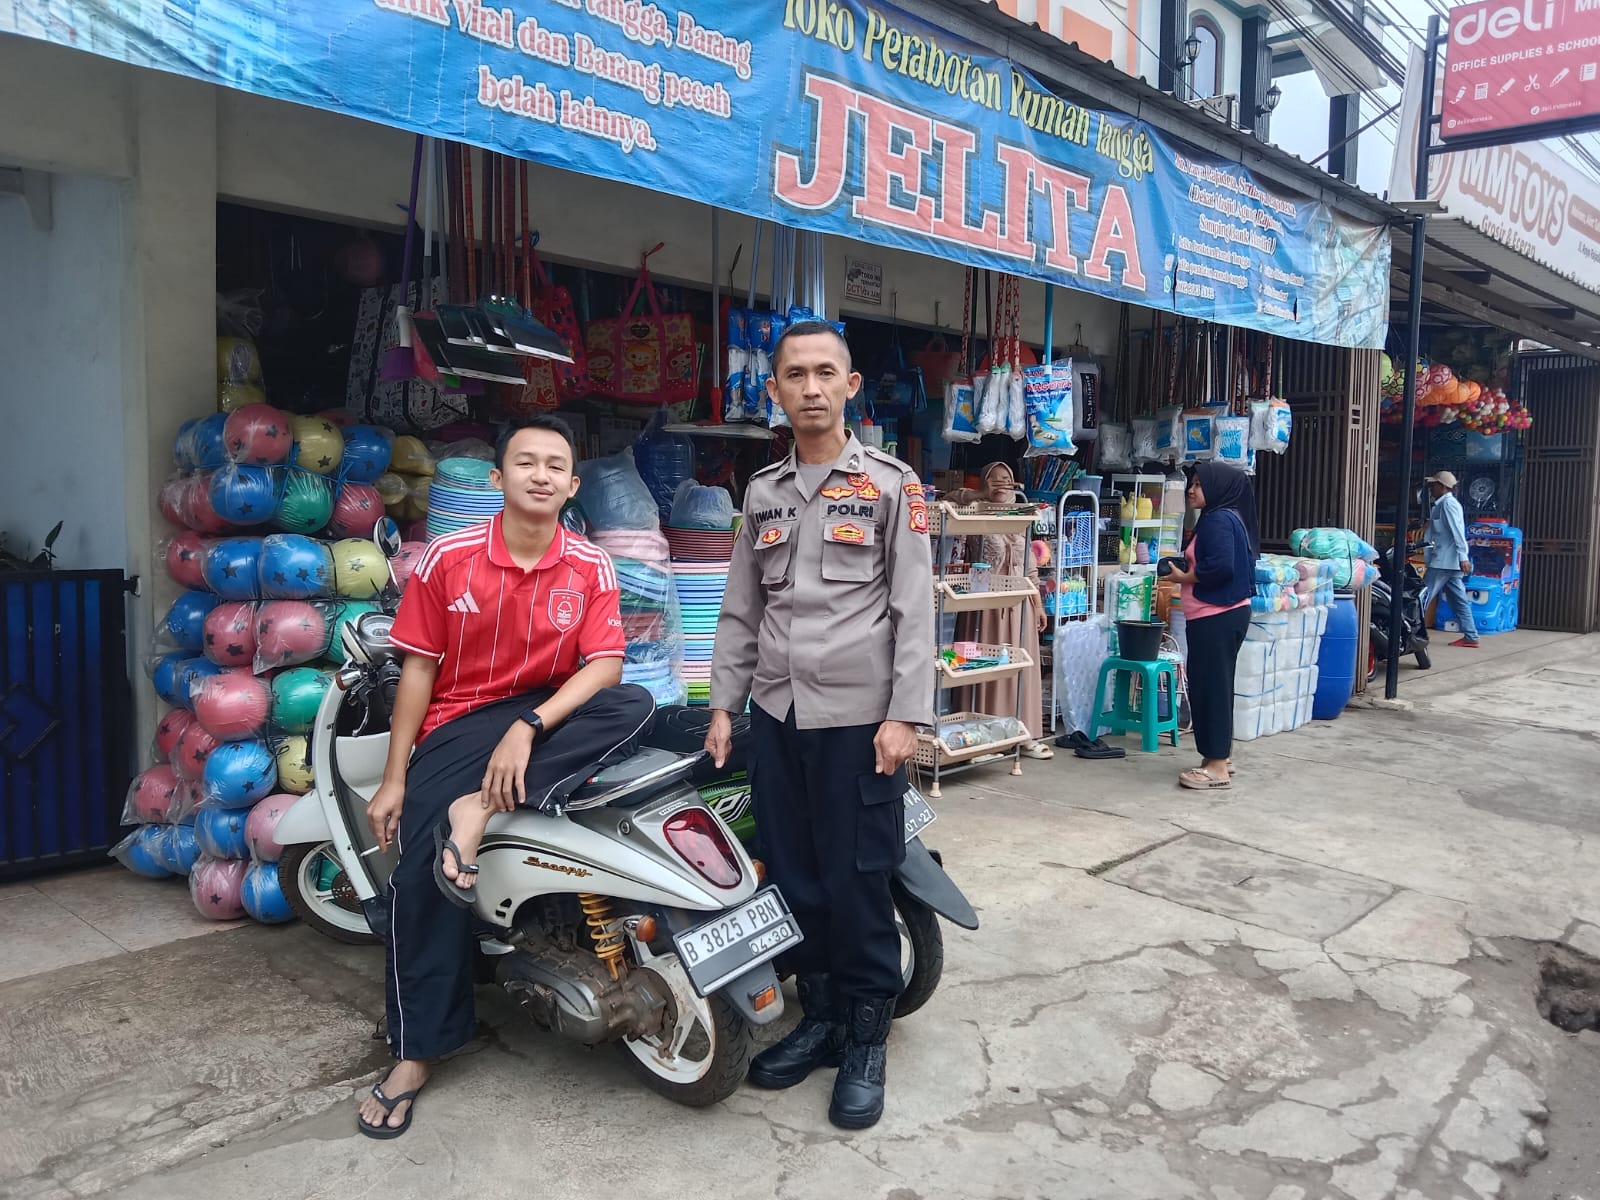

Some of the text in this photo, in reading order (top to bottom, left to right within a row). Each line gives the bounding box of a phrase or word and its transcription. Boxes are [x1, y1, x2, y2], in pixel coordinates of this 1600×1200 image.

[676, 11, 752, 79] Barang
[1453, 0, 1556, 45] deli
[454, 0, 515, 48] Viral
[517, 17, 570, 66] dan
[574, 33, 661, 104] Barang
[663, 71, 731, 118] pecah
[862, 7, 1002, 110] Perabotan
[1451, 57, 1487, 73] OFFICE
[1490, 46, 1543, 66] SUPPLIES
[1545, 44, 1555, 55] &
[478, 65, 657, 153] belah lainnya.
[774, 72, 1147, 291] JELITA
[755, 506, 797, 524] IWAN K
[827, 503, 874, 519] POLRI
[522, 856, 593, 877] Scoopy
[683, 898, 779, 962] B 3825 PBN
